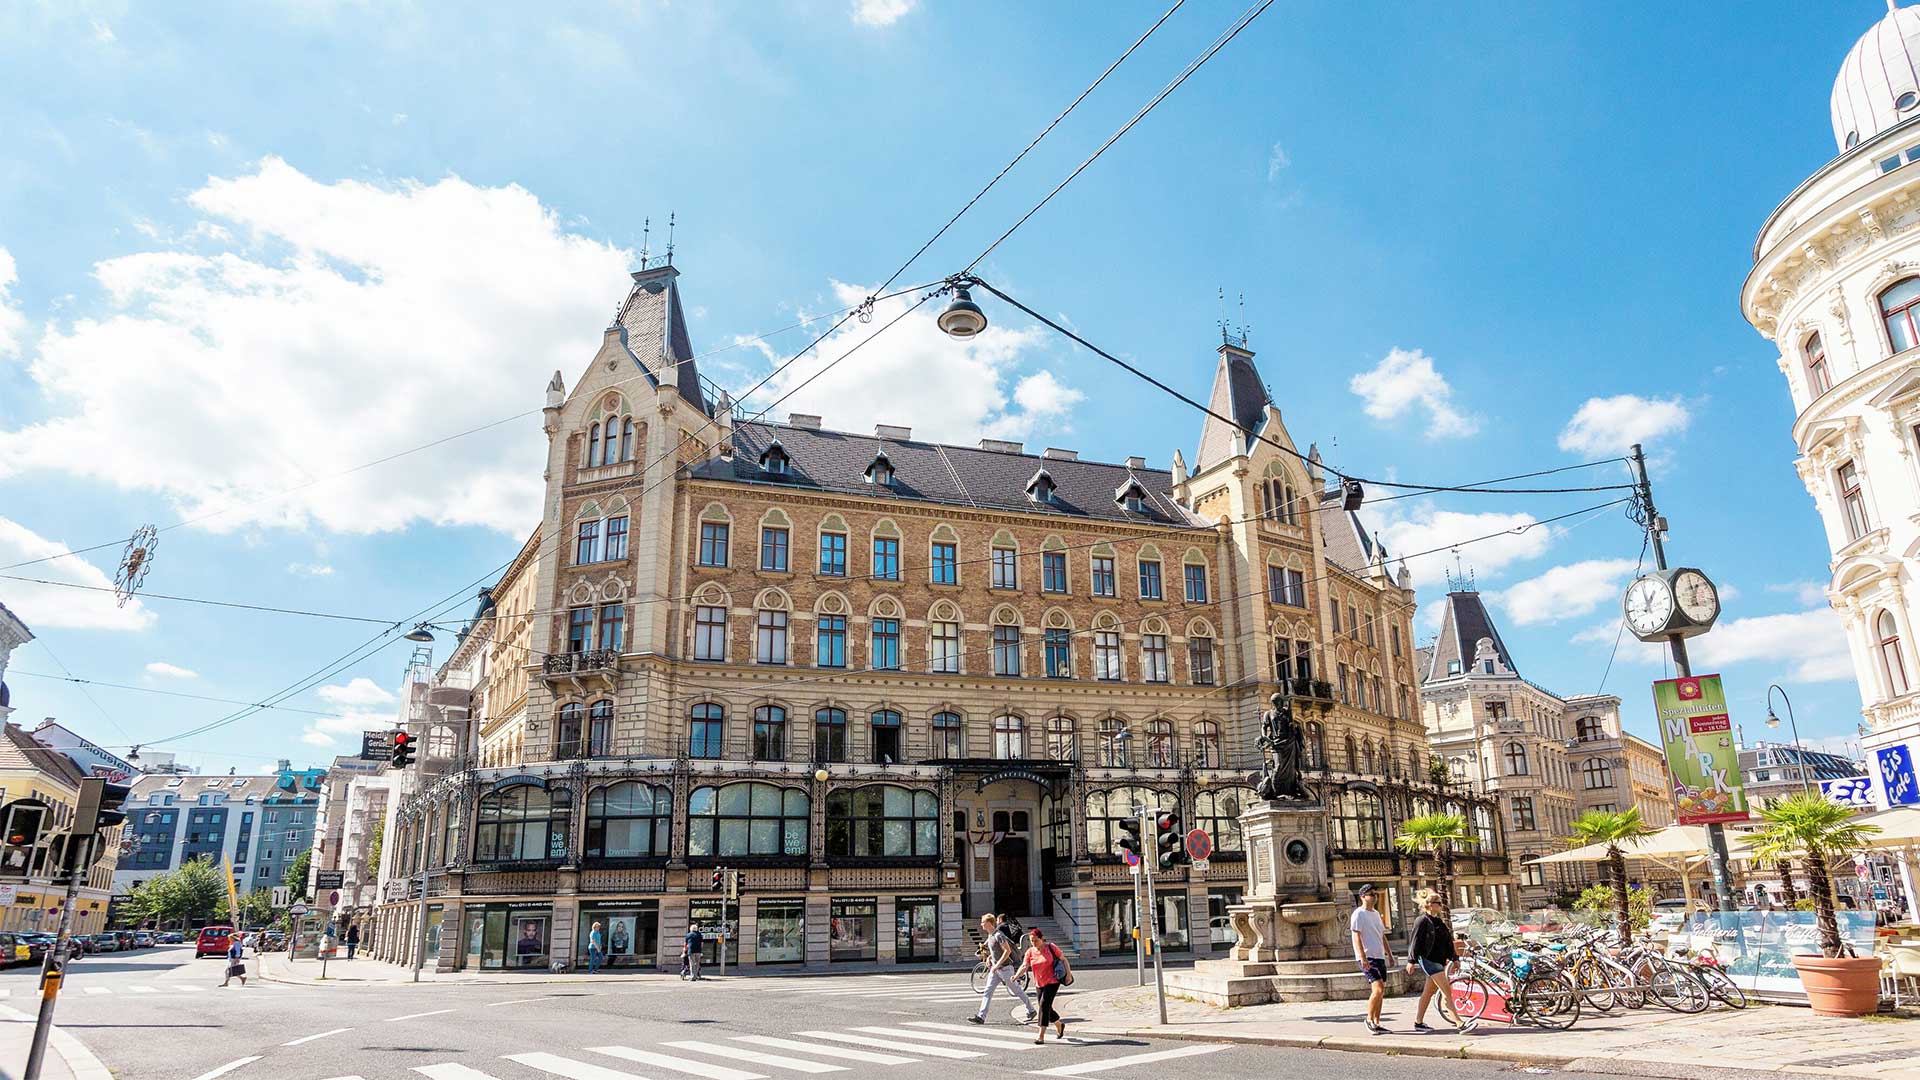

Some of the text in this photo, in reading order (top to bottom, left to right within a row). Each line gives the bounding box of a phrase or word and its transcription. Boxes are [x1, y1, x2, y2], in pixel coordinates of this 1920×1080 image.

[1662, 702, 1724, 717] Spezialitäten
[1664, 717, 1742, 812] MARKT
[1881, 750, 1902, 783] Eis
[551, 832, 563, 840] be
[785, 830, 799, 839] be
[1691, 923, 1738, 938] Gelateria
